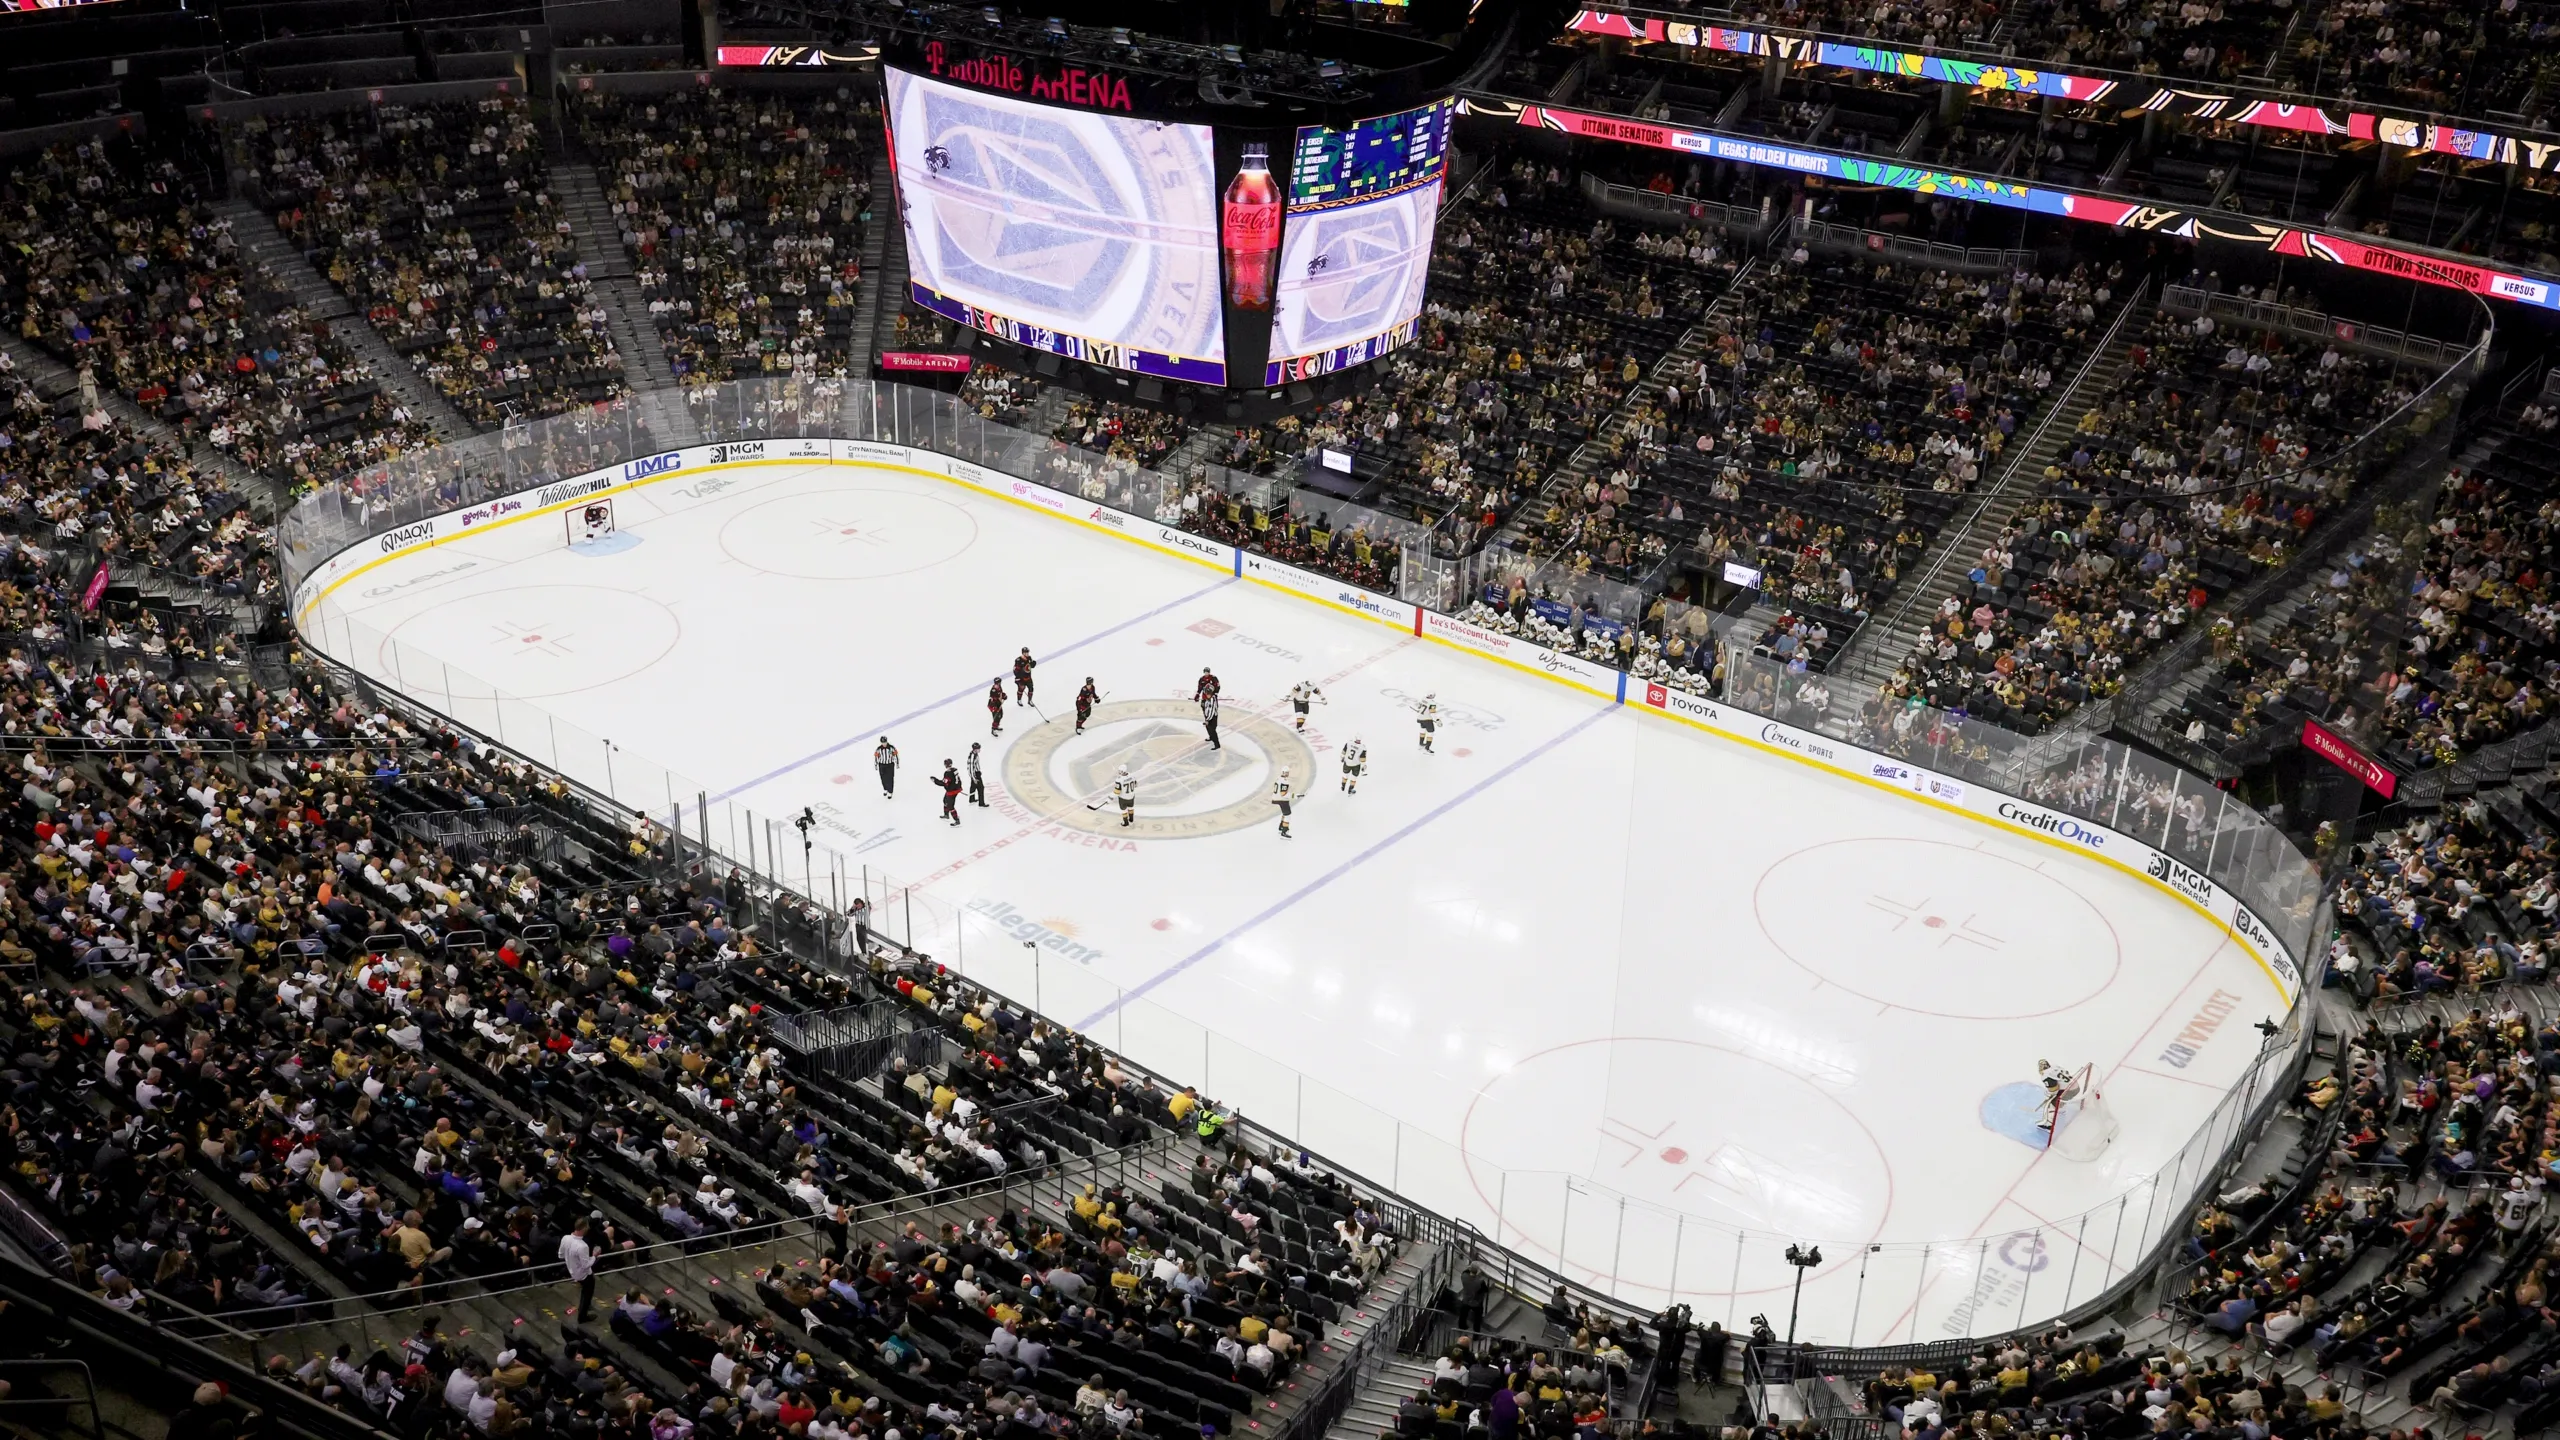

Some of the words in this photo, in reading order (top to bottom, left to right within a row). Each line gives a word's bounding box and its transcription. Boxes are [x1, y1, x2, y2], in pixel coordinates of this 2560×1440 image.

[1031, 67, 1132, 111] ARENA
[1581, 119, 1616, 137] OTTAWA
[1617, 124, 1663, 145] SENATORS
[1680, 137, 1702, 148] VERSUS
[1718, 141, 1748, 158] VEGAS
[1749, 147, 1786, 165] GOLDEN
[1787, 153, 1828, 172] KNIGHTS
[1227, 206, 1277, 230] Coca-Cola
[2363, 250, 2413, 274] OTTAWA
[2415, 261, 2481, 289] SENATORS
[2503, 281, 2535, 297] VERSUS
[1029, 326, 1055, 345] 17:20
[1066, 337, 1076, 357] 0
[1347, 340, 1367, 357] 17:20
[900, 357, 923, 366] Mobile
[730, 443, 764, 454] MGM
[730, 454, 765, 462] REWARDS
[861, 447, 889, 456] NATIONAL
[889, 450, 905, 458] BANK
[624, 453, 680, 481] UMC
[1030, 491, 1064, 509] Insurance
[462, 511, 490, 527] Booster
[499, 501, 522, 515] Juice
[1102, 511, 1125, 527] GARAGE
[393, 521, 434, 544] NAQVI
[1174, 535, 1219, 556] LEXUS
[394, 562, 478, 588] LEXUS
[1338, 591, 1402, 621] allegiant.com
[1430, 615, 1449, 630] Lee's
[1450, 622, 1484, 641] Discount
[1484, 633, 1511, 649] Liquor
[1231, 633, 1303, 663] TOYOTA
[1671, 696, 1718, 720] TOYOTA
[1761, 723, 1801, 749] Circa
[1807, 744, 1834, 759] SPORTS
[2320, 736, 2345, 761] Mobile
[1348, 749, 1356, 760] 3
[1122, 781, 1135, 794] 70
[810, 812, 862, 840] ATIONAL
[1998, 802, 2104, 848] CreditOne
[1040, 826, 1139, 853] ARENA
[2171, 879, 2209, 907] REWARDS
[2173, 864, 2212, 898] MGM
[966, 897, 1104, 966] allegiant
